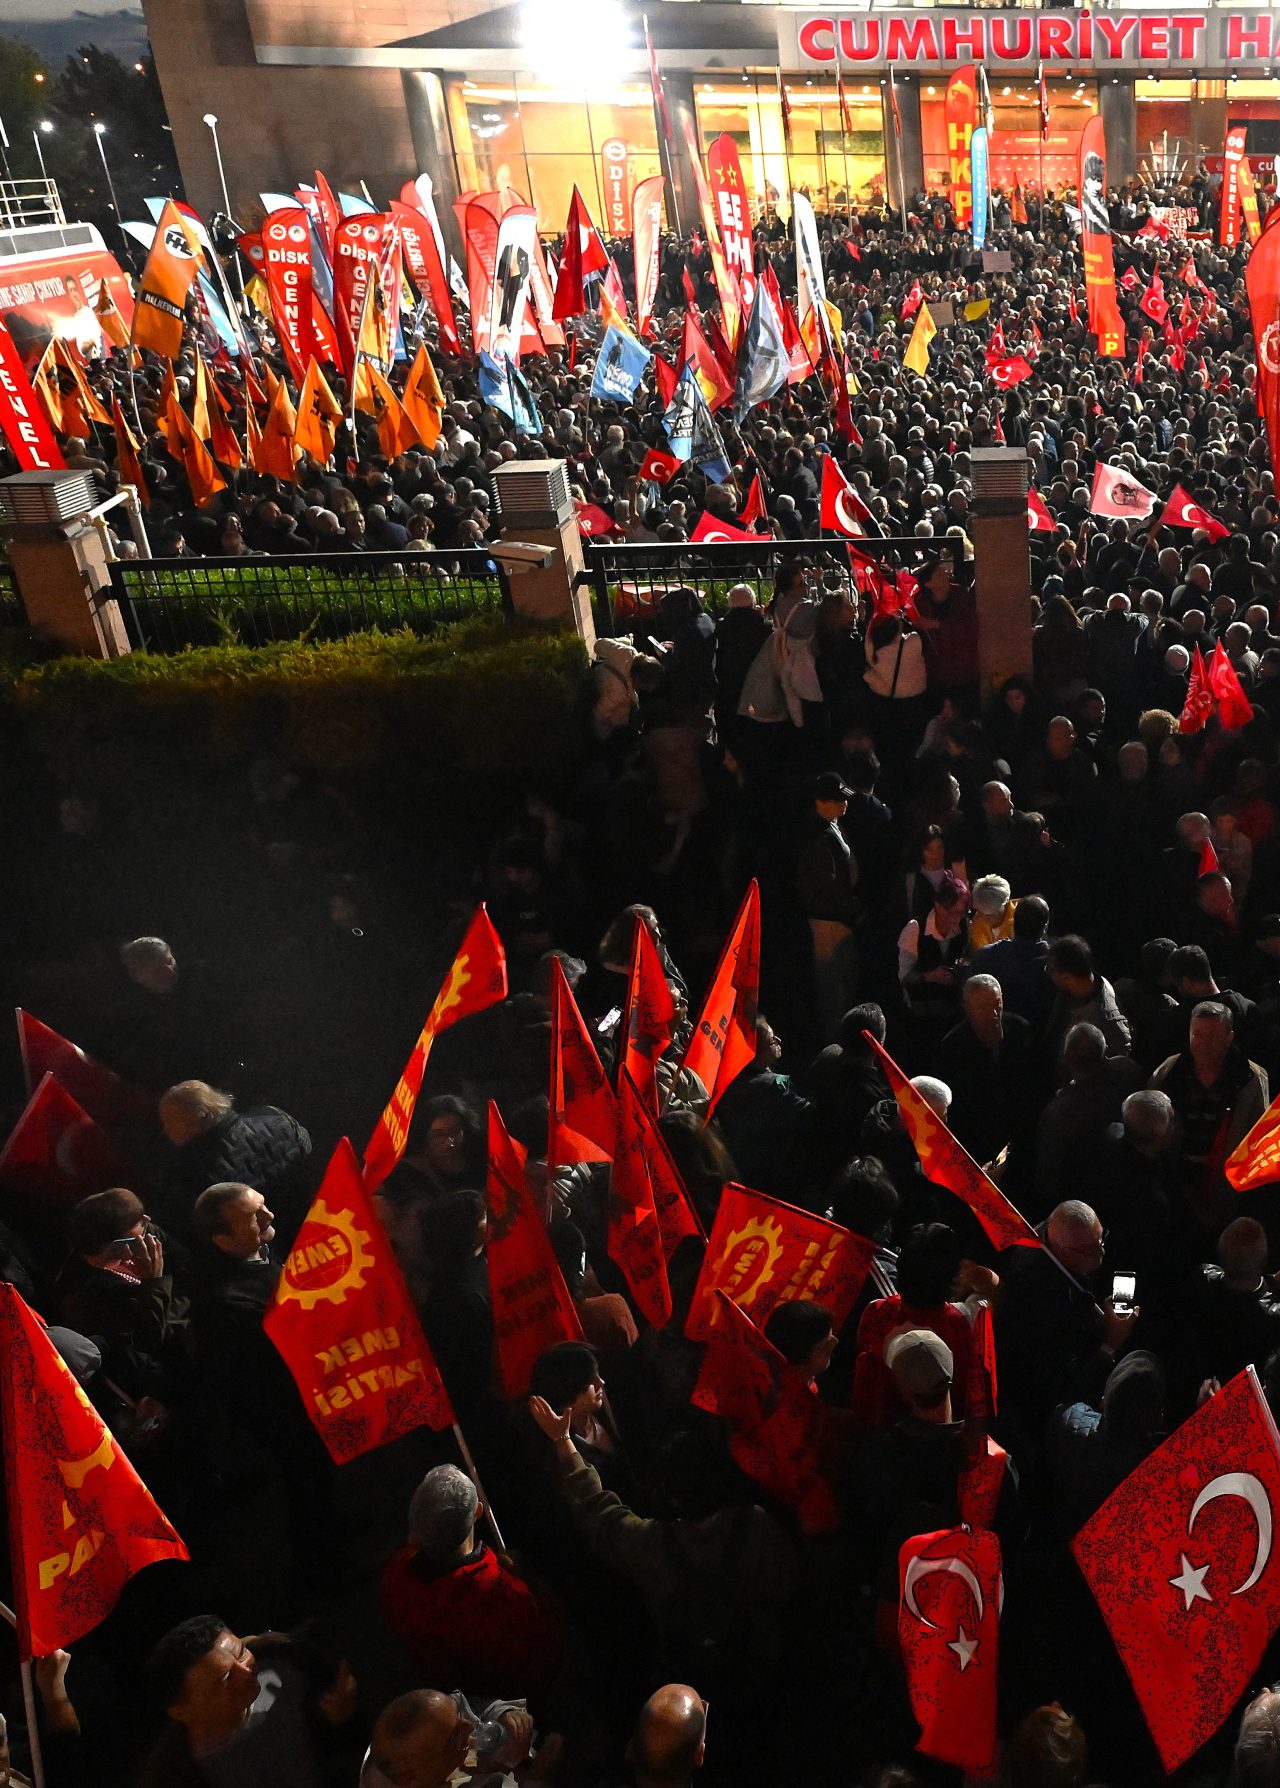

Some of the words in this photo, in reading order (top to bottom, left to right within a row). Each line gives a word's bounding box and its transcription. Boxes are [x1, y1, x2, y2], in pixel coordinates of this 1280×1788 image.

[799, 9, 1206, 61] CUMHURİYET
[609, 166, 626, 232] DİSK
[948, 123, 973, 217] HKP
[268, 247, 310, 265] DİSK
[339, 242, 380, 263] DİSK
[283, 270, 301, 353] GENEL
[0, 368, 50, 468] ENEL
